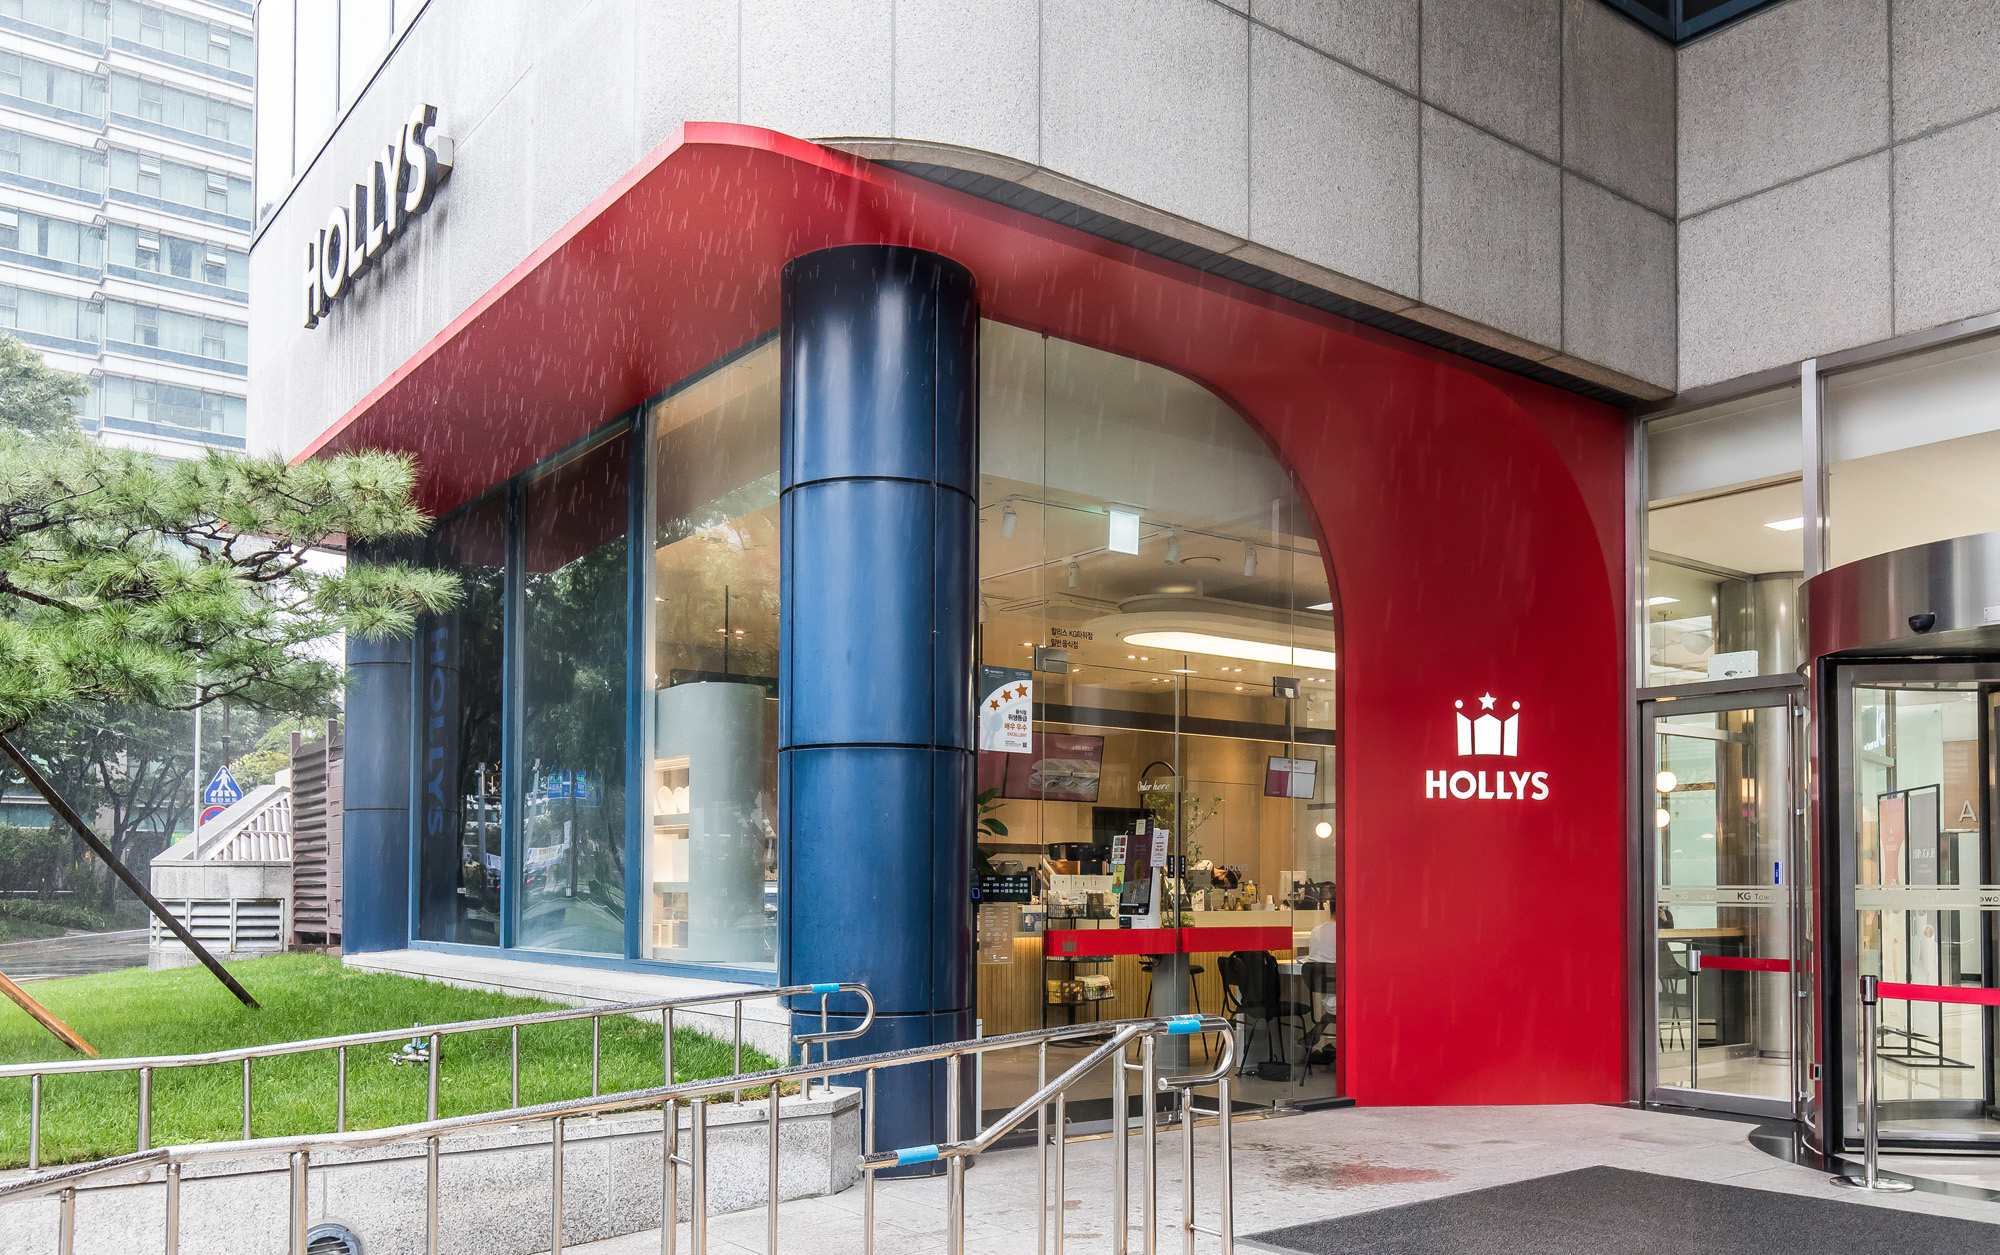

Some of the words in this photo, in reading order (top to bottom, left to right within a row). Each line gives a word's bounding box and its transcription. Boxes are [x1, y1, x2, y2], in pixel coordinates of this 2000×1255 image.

[303, 103, 436, 328] HOLLYS
[427, 627, 446, 836] HOLLYS
[1016, 723, 1028, 732] 우수
[1152, 780, 1171, 791] here
[1425, 769, 1550, 801] HOLLYS
[1737, 891, 1752, 901] KG
[1754, 893, 1776, 901] Tow
